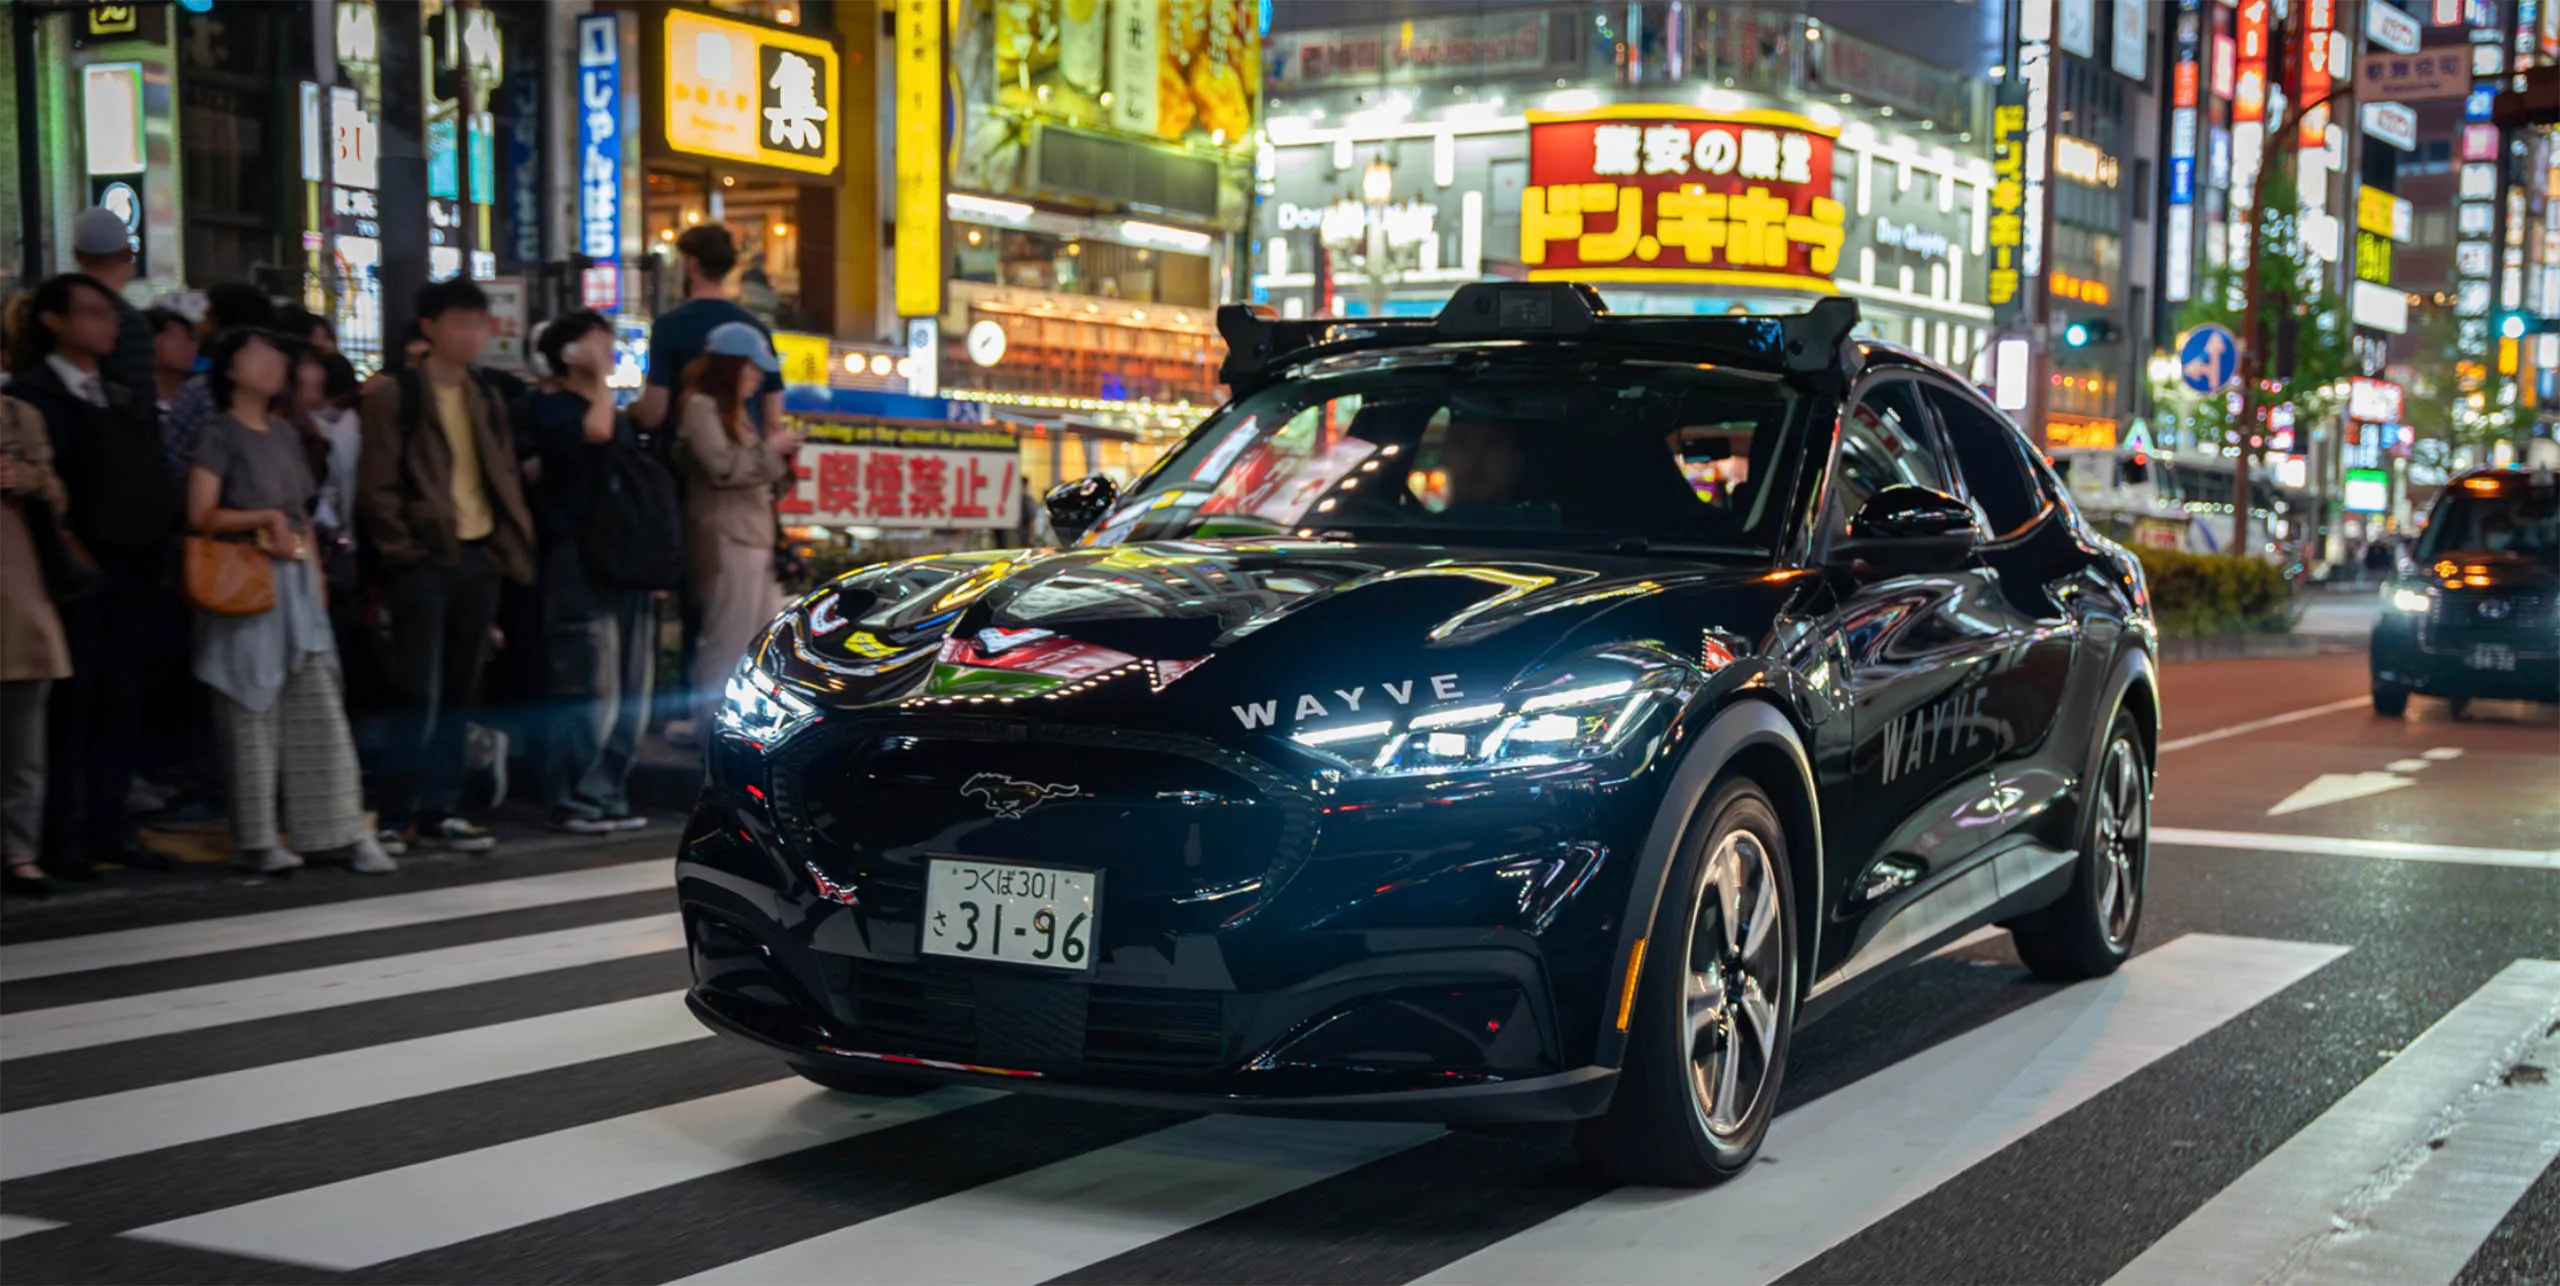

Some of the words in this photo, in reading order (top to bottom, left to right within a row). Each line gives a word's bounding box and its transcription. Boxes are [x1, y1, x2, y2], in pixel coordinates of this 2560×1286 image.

[1231, 673, 1465, 730] WAYVE
[1882, 686, 1988, 784] WAYVE
[963, 868, 1056, 900] つくば301
[933, 911, 946, 936] さ
[955, 901, 1088, 963] 31-96
